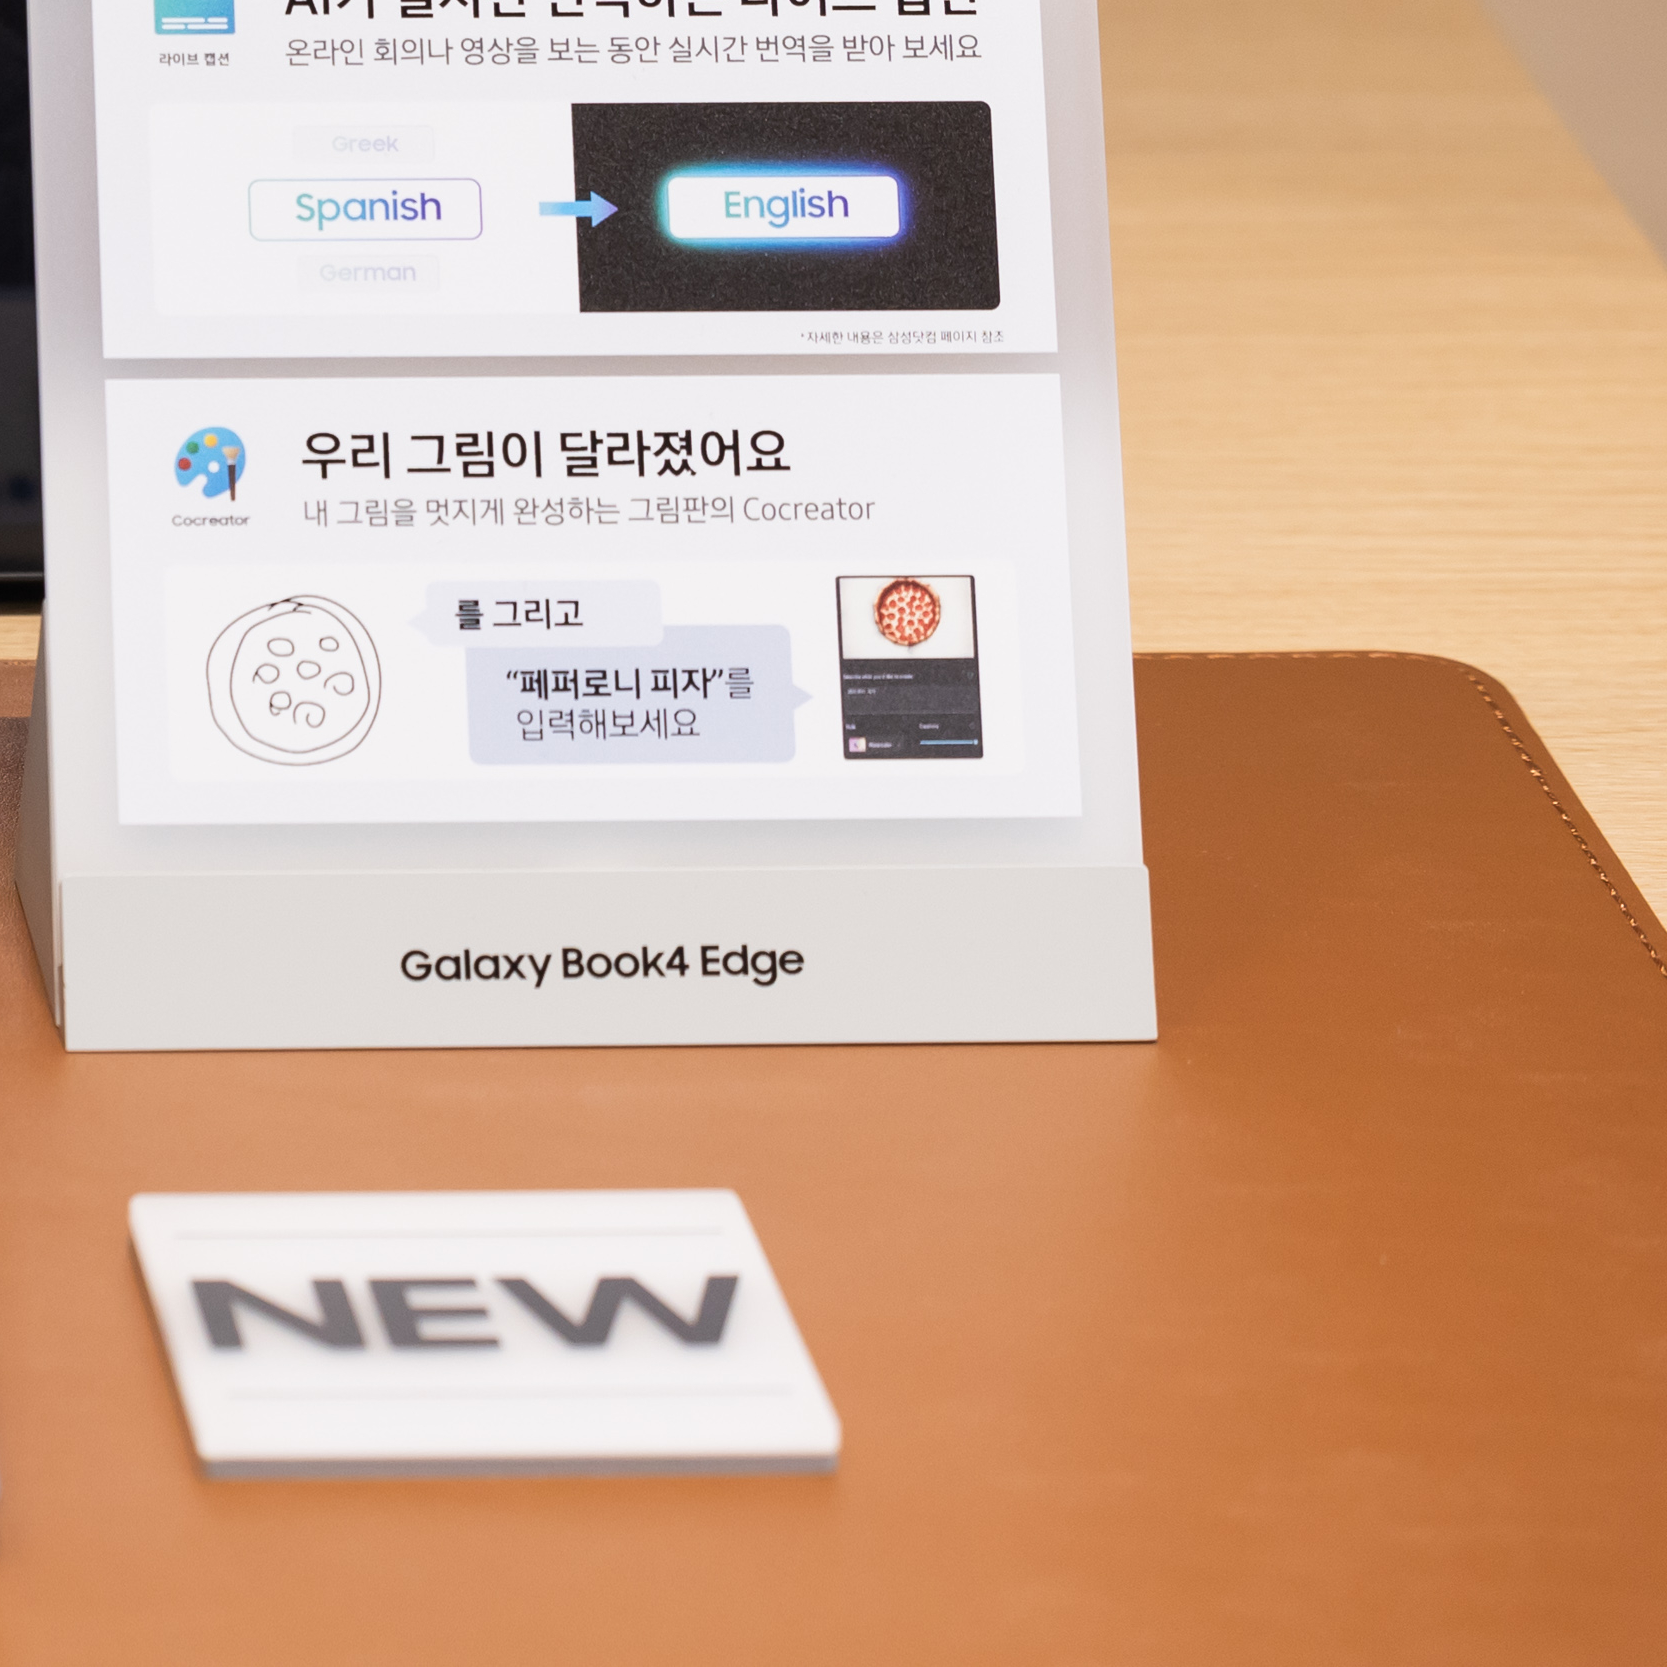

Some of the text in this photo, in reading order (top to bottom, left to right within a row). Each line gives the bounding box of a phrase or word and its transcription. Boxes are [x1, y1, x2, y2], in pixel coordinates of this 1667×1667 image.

[160, 53, 229, 67] 라이브 캡션
[286, 34, 981, 66] 온라인 회의나 영상을 보는 동안 실시간 번역을 받아 보세요
[333, 135, 399, 152] Greek
[297, 190, 441, 231] Spanish
[725, 187, 848, 229] English
[320, 264, 416, 281] German
[302, 429, 790, 480] 우리 그림이 달라졌어요
[172, 515, 249, 526] Cocreator
[305, 496, 875, 527] 내 그림을 멋지게 완성하는 그림판의 Cocreator
[456, 599, 583, 630] 를 그리고
[517, 708, 699, 741] 입력해보세요
[401, 944, 804, 988] Galaxy Book4 Edge
[189, 1274, 739, 1349] NEW
